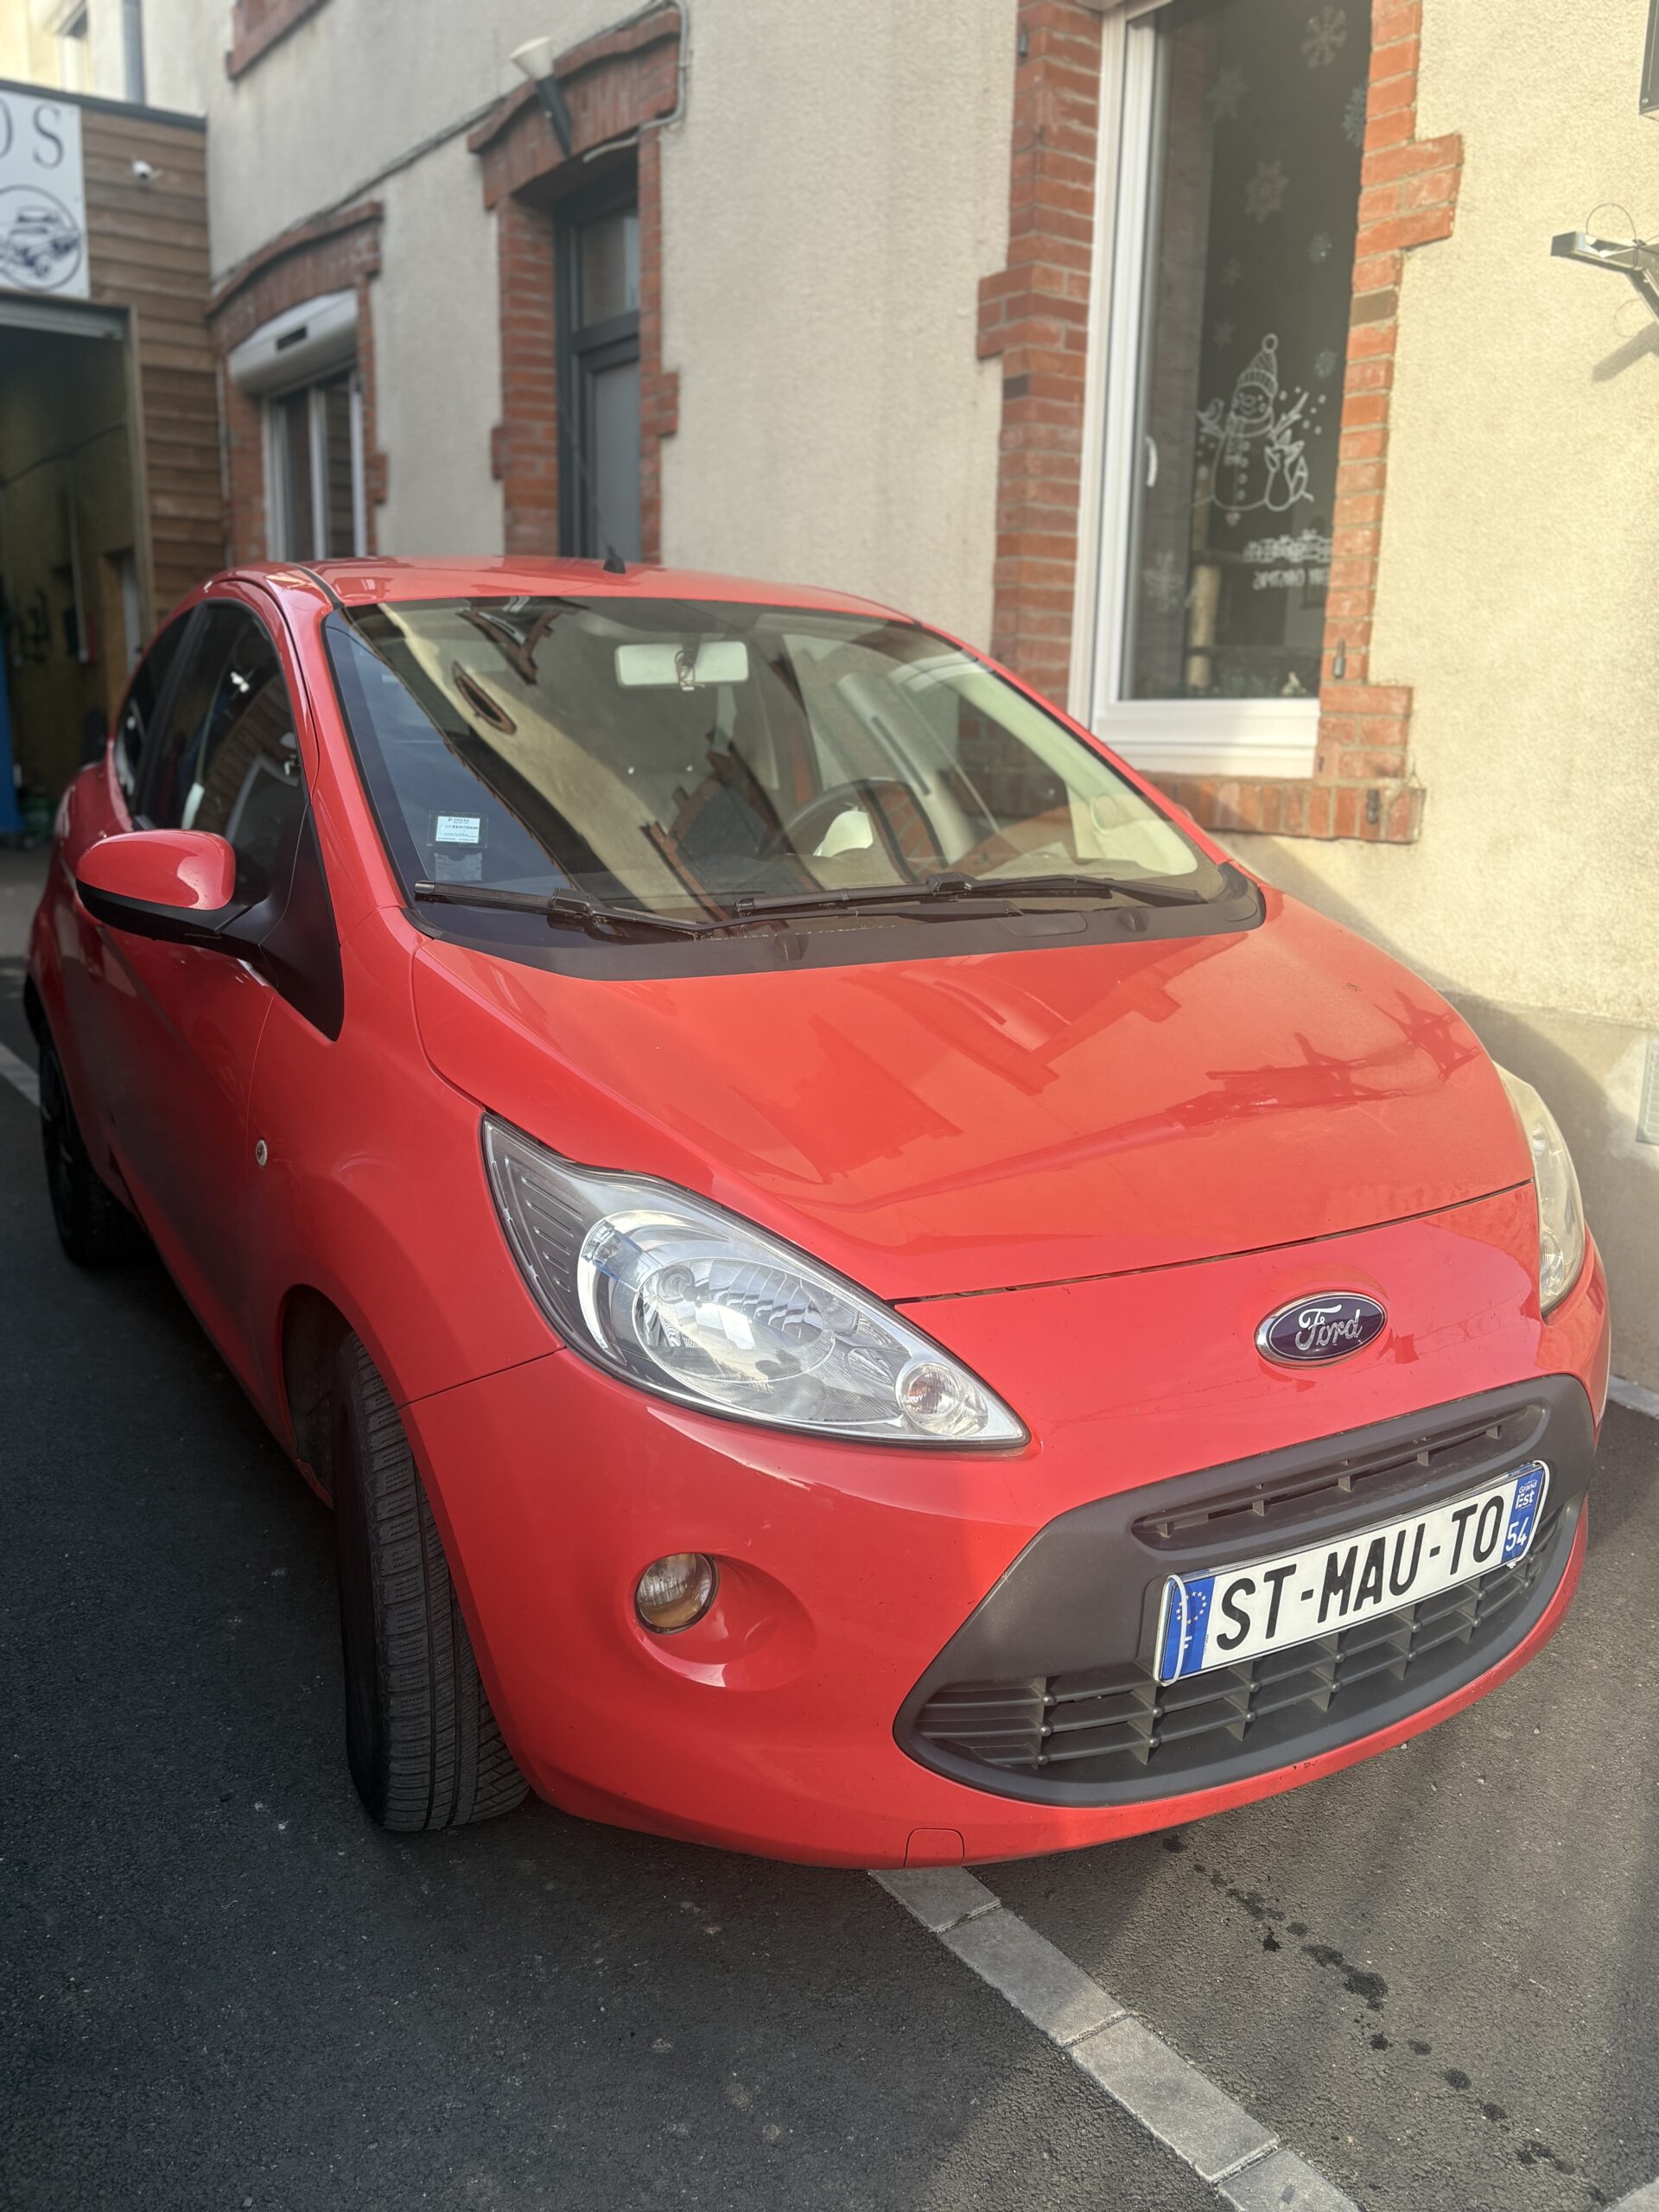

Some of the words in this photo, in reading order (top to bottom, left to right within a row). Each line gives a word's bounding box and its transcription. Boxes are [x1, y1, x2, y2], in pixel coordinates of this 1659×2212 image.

[1295, 1304, 1363, 1351] Ford
[1515, 1490, 1535, 1510] Est
[1518, 1480, 1538, 1494] Grand
[1505, 1516, 1529, 1552] 54
[1217, 1496, 1504, 1650] ST-MAU-TO
